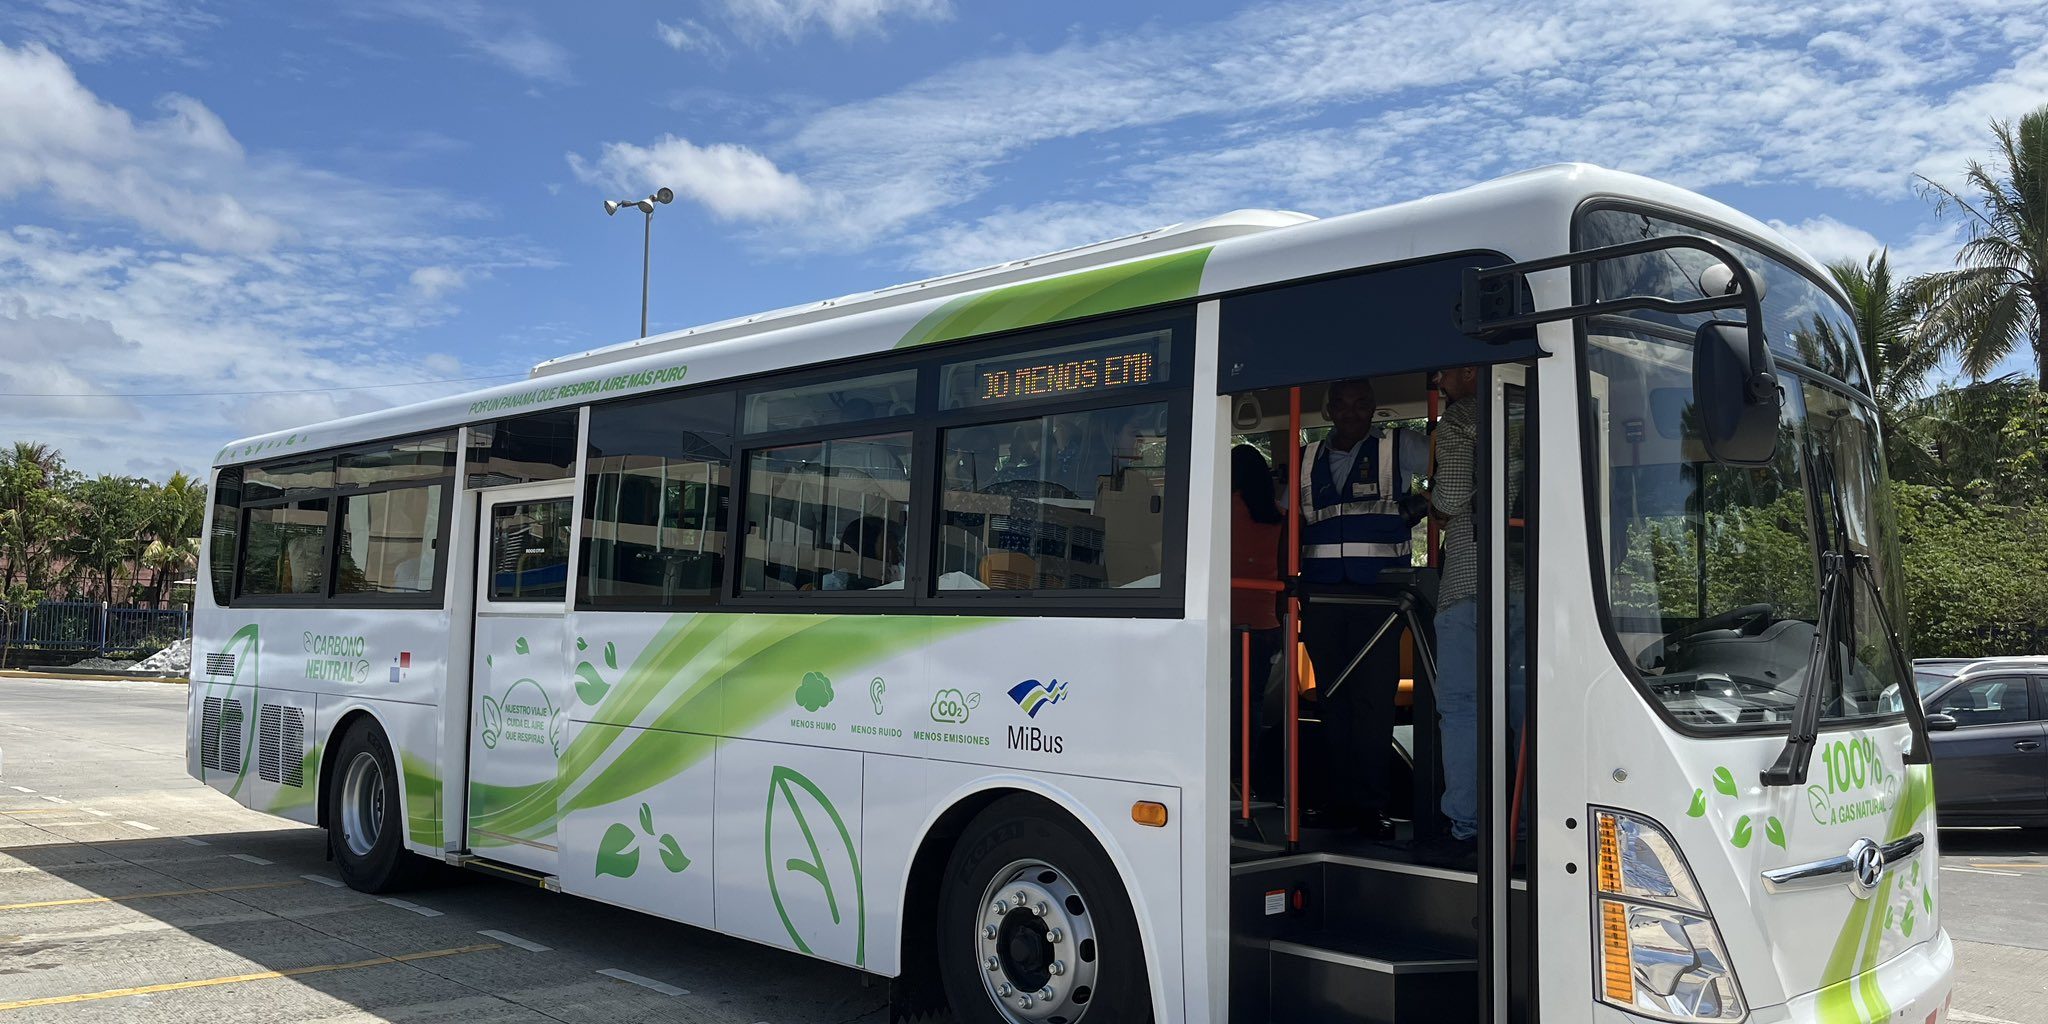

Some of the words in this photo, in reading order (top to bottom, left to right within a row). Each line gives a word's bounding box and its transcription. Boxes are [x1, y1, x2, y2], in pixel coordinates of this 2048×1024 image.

[1014, 359, 1098, 396] MENOS
[1104, 352, 1152, 386] EMI
[468, 400, 489, 415] POR
[487, 398, 500, 412] UN
[499, 388, 539, 409] PANAMÁ
[537, 386, 558, 403] QUE
[556, 380, 600, 399] RESPIRA
[600, 375, 630, 393] AIRE
[626, 369, 654, 389] MÁS
[652, 365, 688, 384] PURO
[314, 635, 364, 657] CARBONO
[305, 659, 354, 682] NEUTRAL
[505, 704, 530, 716] NUESTRO
[531, 706, 548, 717] VIAJE
[506, 717, 523, 728] CUIDA
[524, 719, 531, 729] EL
[532, 720, 544, 730] AIRE
[790, 720, 814, 729] MENOS
[816, 721, 837, 731] HUMO
[851, 725, 877, 735] MENOS
[878, 727, 902, 737] RUIDO
[505, 731, 517, 741] QUE
[518, 732, 545, 744] RESPIRAS
[913, 731, 942, 742] MENOS
[943, 733, 990, 746] EMISIONES
[1008, 725, 1064, 754] MiBus
[1822, 736, 1883, 794] 100%
[1830, 808, 1837, 825] A
[1838, 803, 1856, 823] GAS
[1855, 797, 1887, 820] NATURAL
